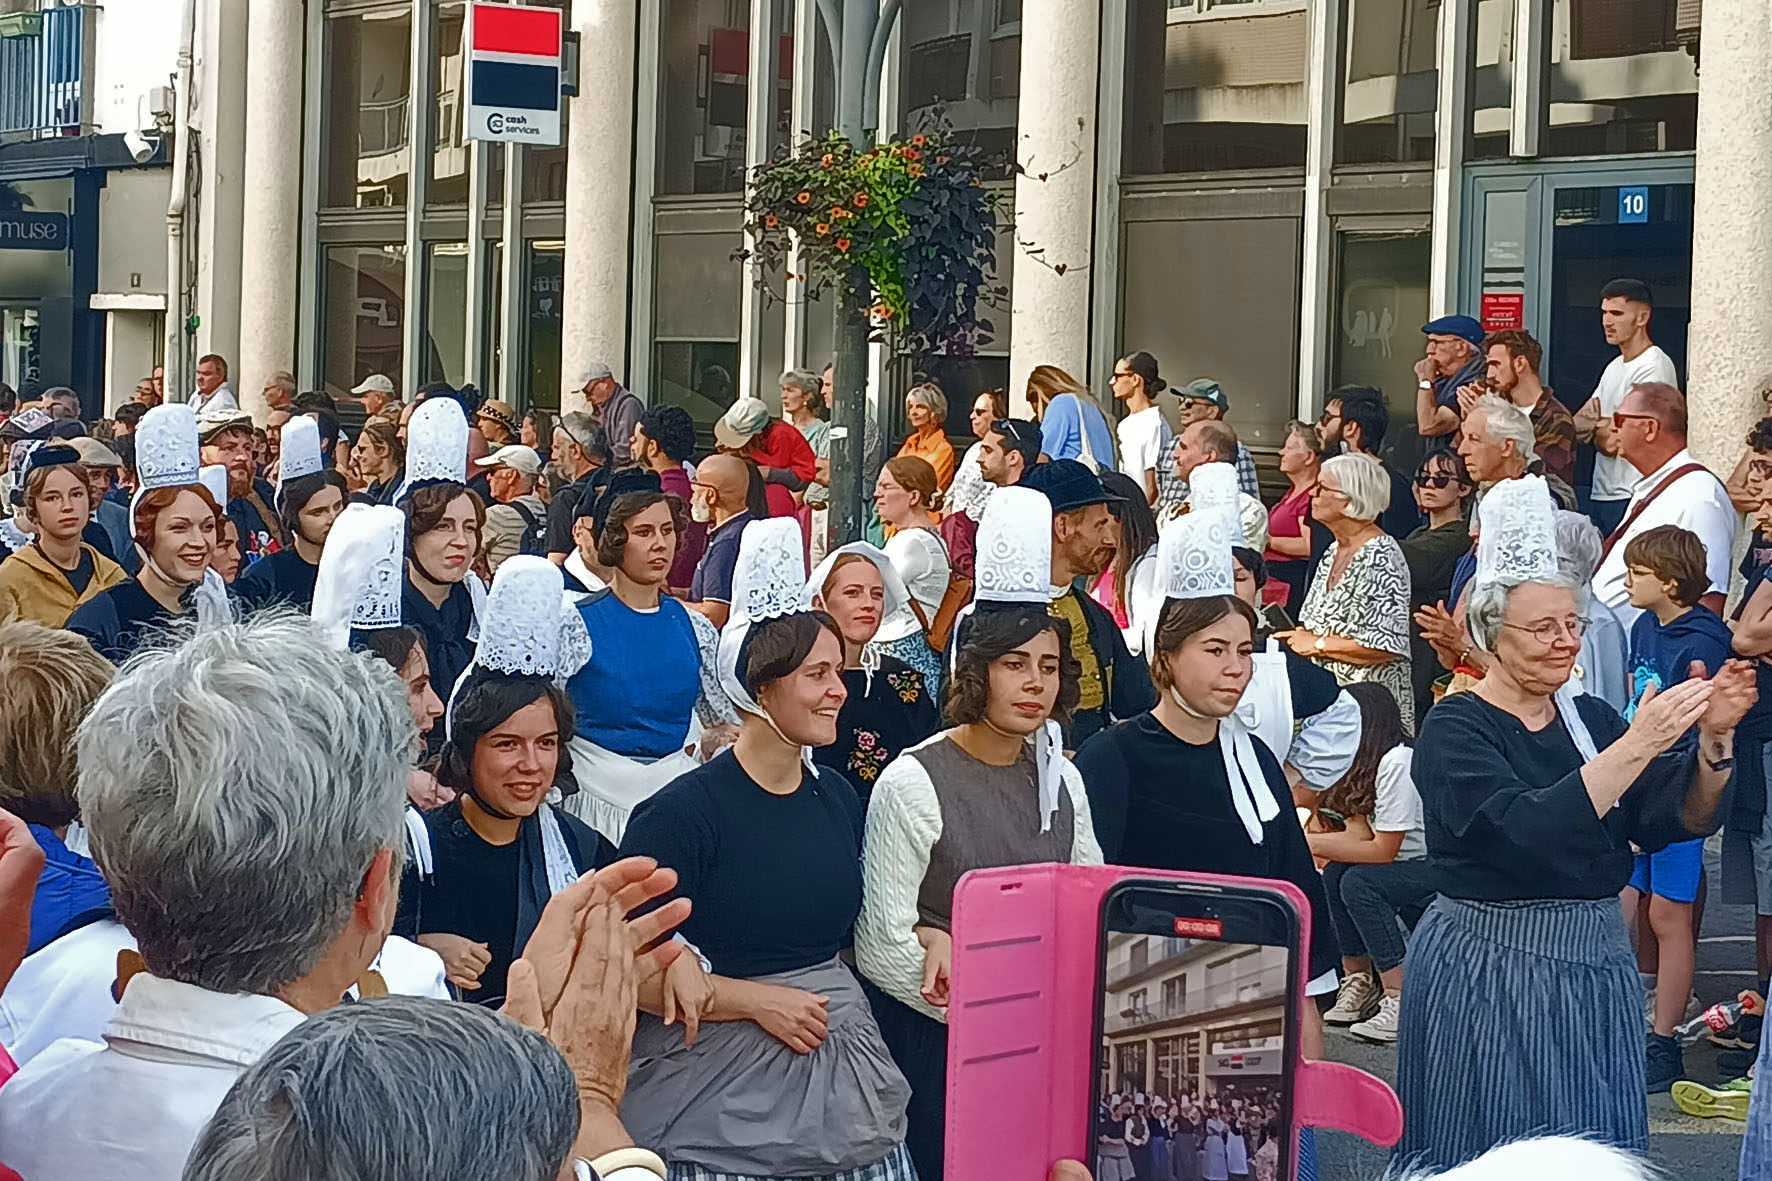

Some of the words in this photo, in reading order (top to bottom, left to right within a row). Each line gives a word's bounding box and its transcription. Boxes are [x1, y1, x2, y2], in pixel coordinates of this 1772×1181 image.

[505, 116, 527, 124] cash
[505, 126, 540, 135] services
[1623, 195, 1644, 214] 10
[0, 221, 57, 239] muse
